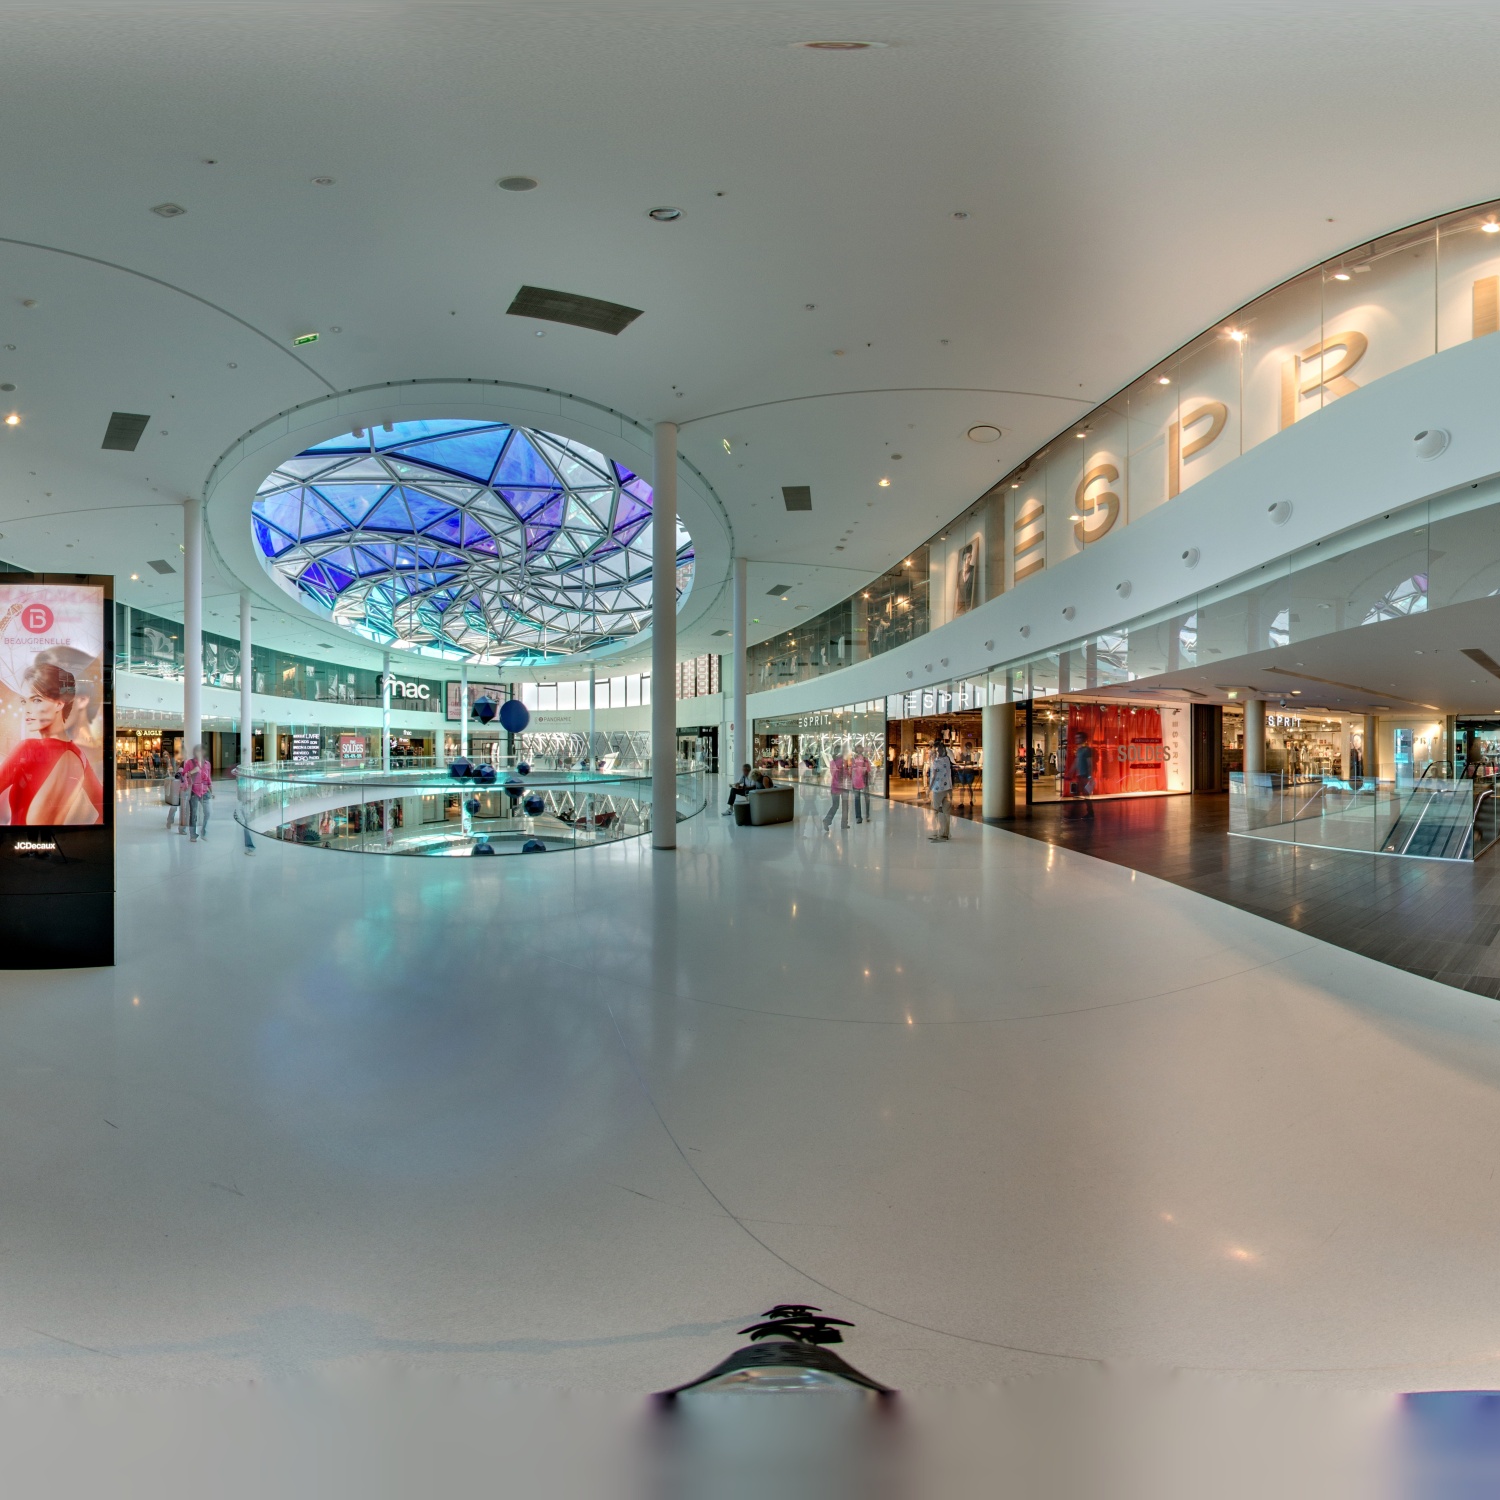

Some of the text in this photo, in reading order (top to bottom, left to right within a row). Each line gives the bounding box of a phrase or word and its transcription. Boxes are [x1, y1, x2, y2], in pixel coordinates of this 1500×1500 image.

[4, 637, 71, 645] BEAUGRENELLE
[798, 714, 830, 728] ESPRIT
[342, 744, 364, 753] SOLDES
[1117, 745, 1171, 762] SOLDES
[14, 842, 56, 850] JCDecaux
